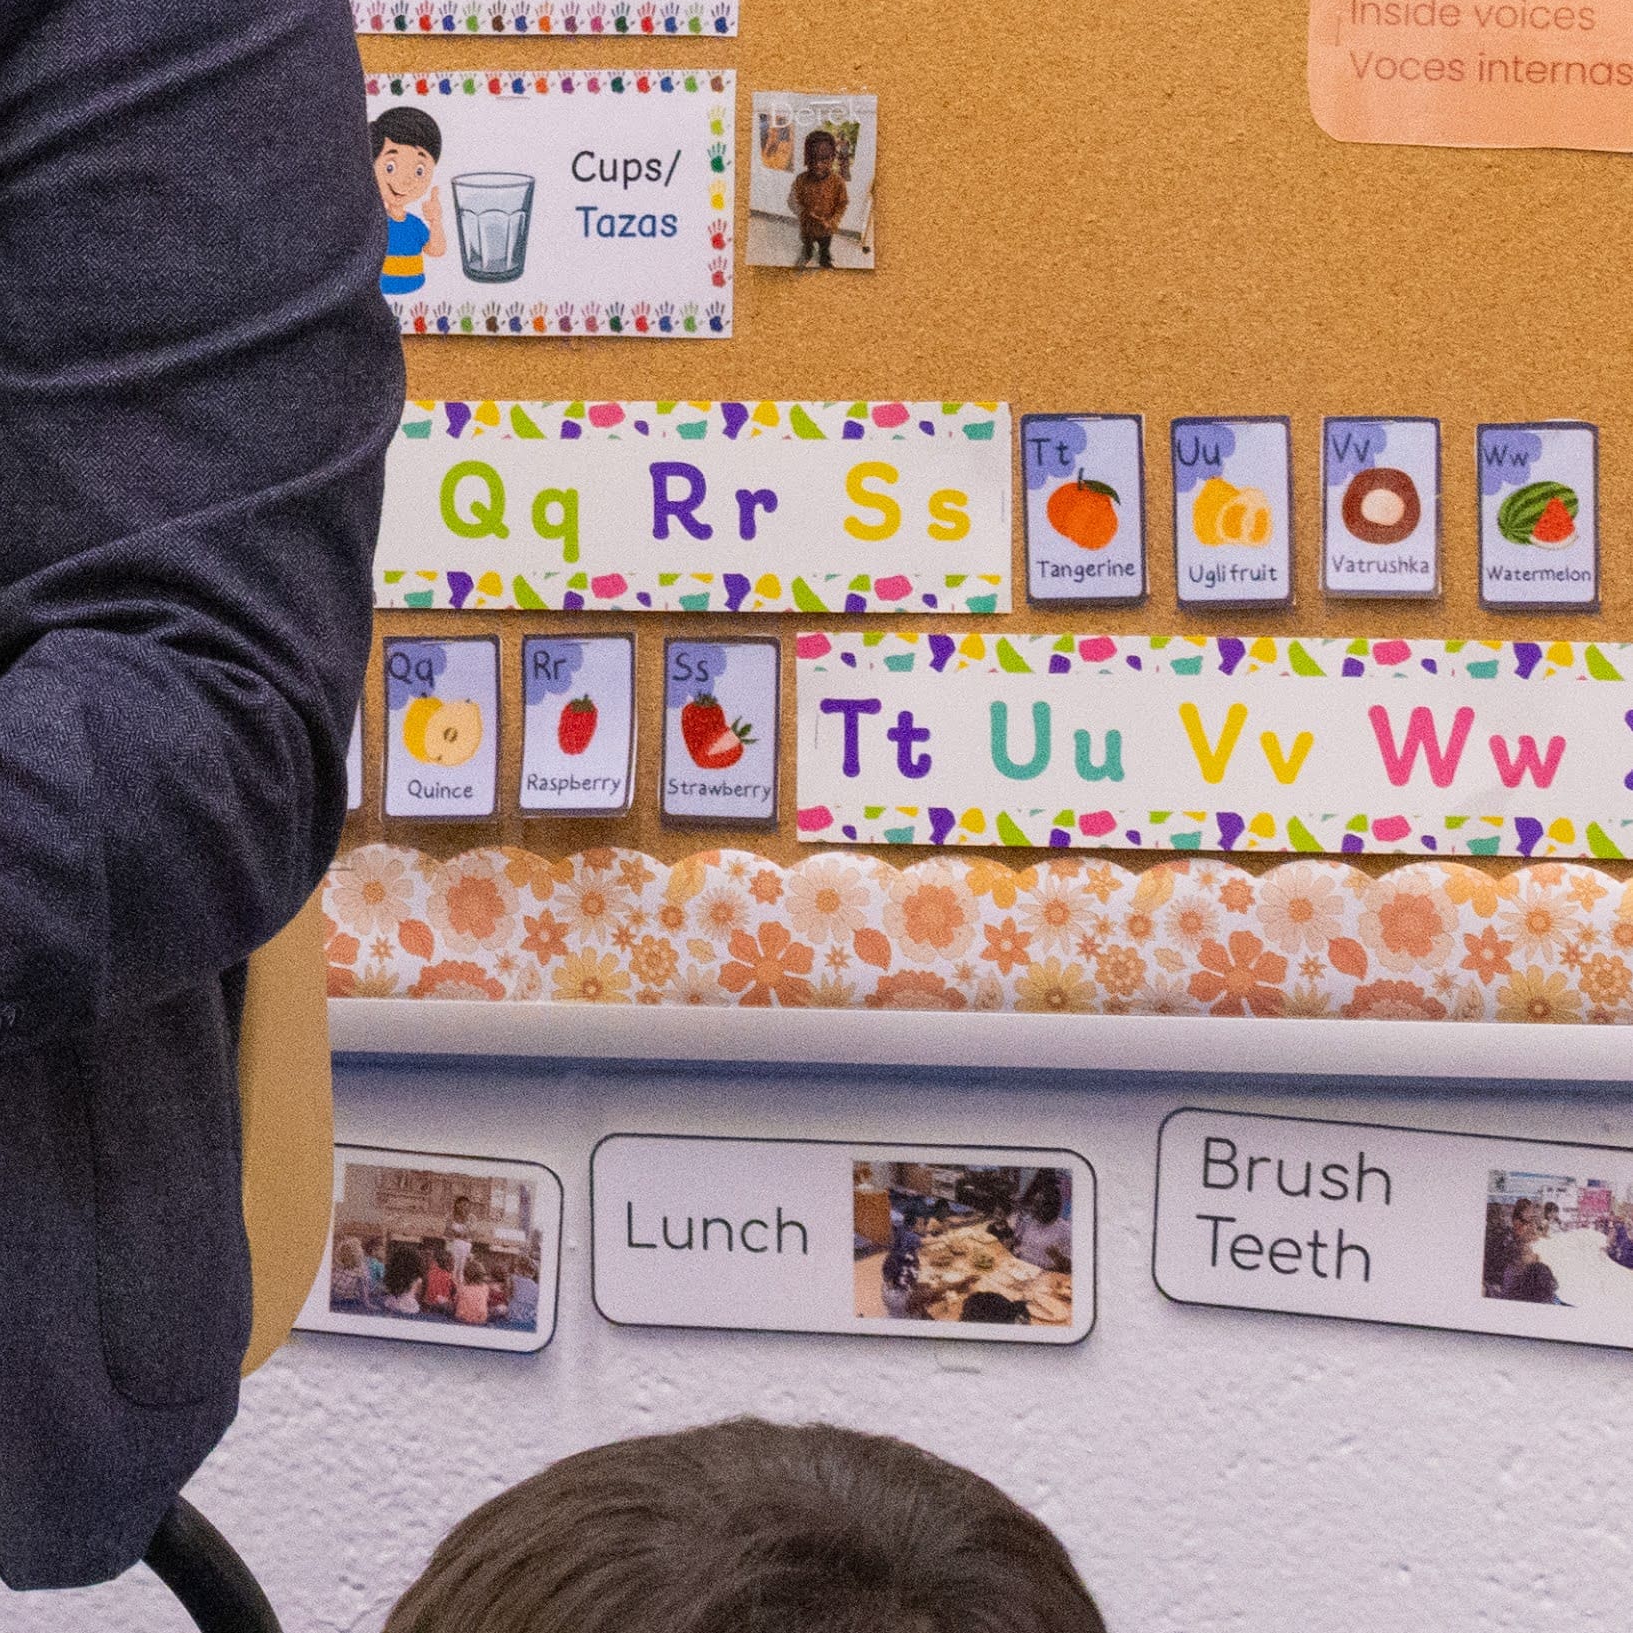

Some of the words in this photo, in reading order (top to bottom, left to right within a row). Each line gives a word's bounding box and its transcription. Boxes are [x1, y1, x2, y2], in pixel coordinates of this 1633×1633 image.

[1474, 0, 1596, 30] voices
[1350, 51, 1465, 82] Voces
[571, 149, 682, 189] Cups/
[575, 205, 678, 238] Tazas
[1036, 557, 1135, 582] Tangerine
[1332, 554, 1429, 574] Vatrushka
[1488, 565, 1591, 583] Watermelon
[408, 779, 474, 799] Quince
[527, 775, 622, 795] Raspberry
[668, 779, 772, 799] Strawberry
[1202, 1137, 1391, 1205] Brush
[626, 1201, 808, 1255] Lunch
[1196, 1214, 1370, 1282] Teeth
